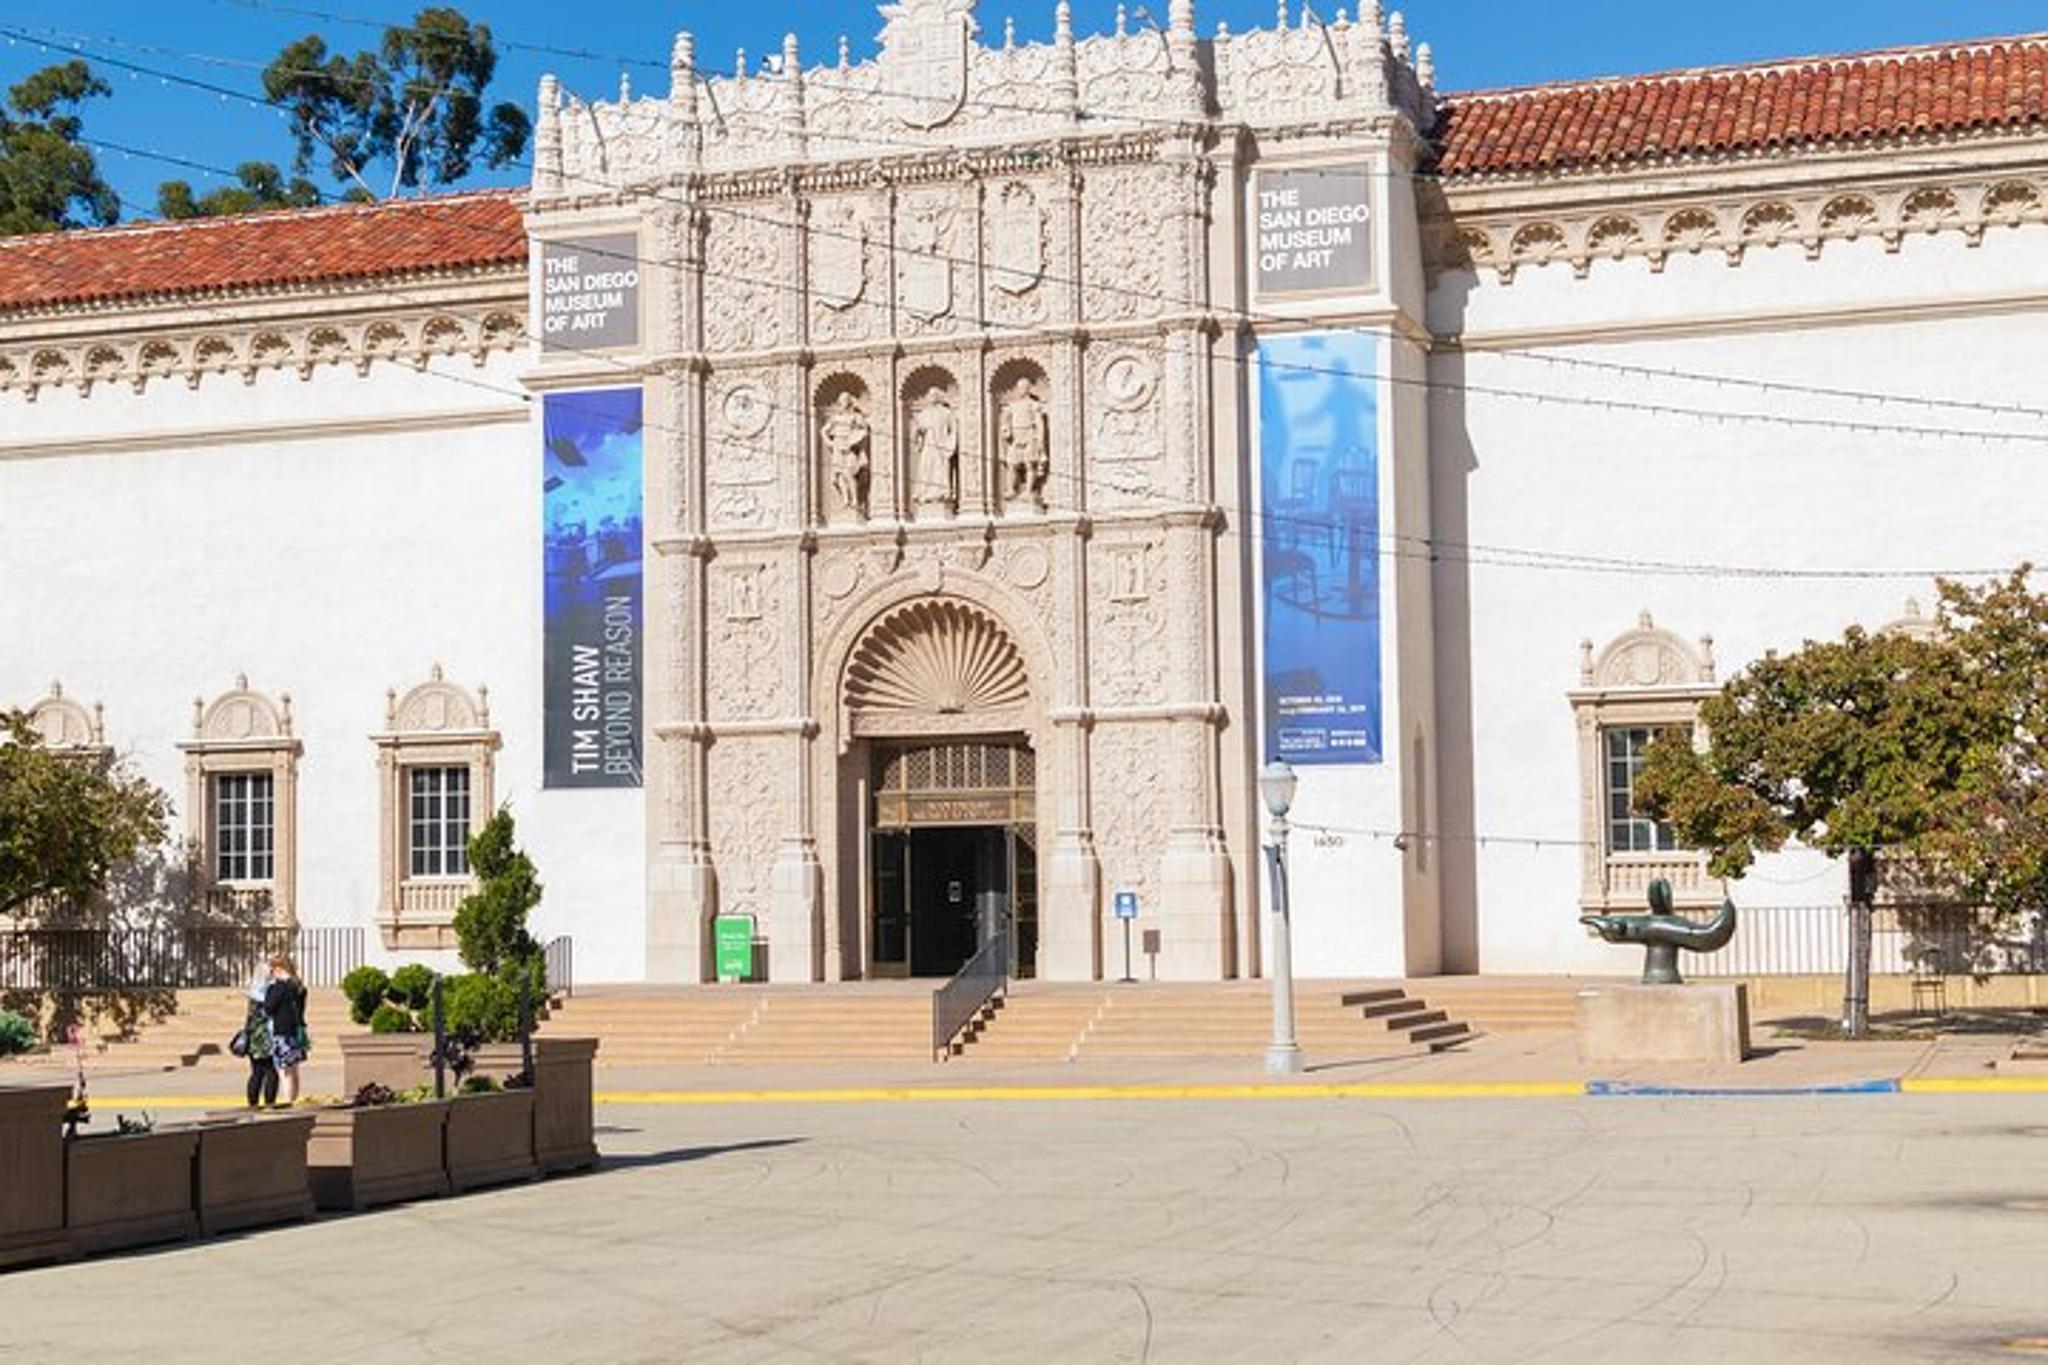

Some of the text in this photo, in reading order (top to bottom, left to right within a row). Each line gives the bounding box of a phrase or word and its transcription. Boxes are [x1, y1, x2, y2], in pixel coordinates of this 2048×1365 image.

[1260, 189, 1299, 208] THE
[1260, 204, 1369, 230] SAN DIEGO
[1260, 227, 1352, 250] MUSEUM
[545, 256, 579, 275] THE
[1261, 250, 1333, 271] OF ART
[545, 270, 638, 294] SAN DIEGO
[545, 291, 623, 313] MUSEUM
[545, 312, 607, 333] OF ART
[604, 596, 633, 775] BEYOND REASON
[572, 644, 600, 774] TIM SHAW
